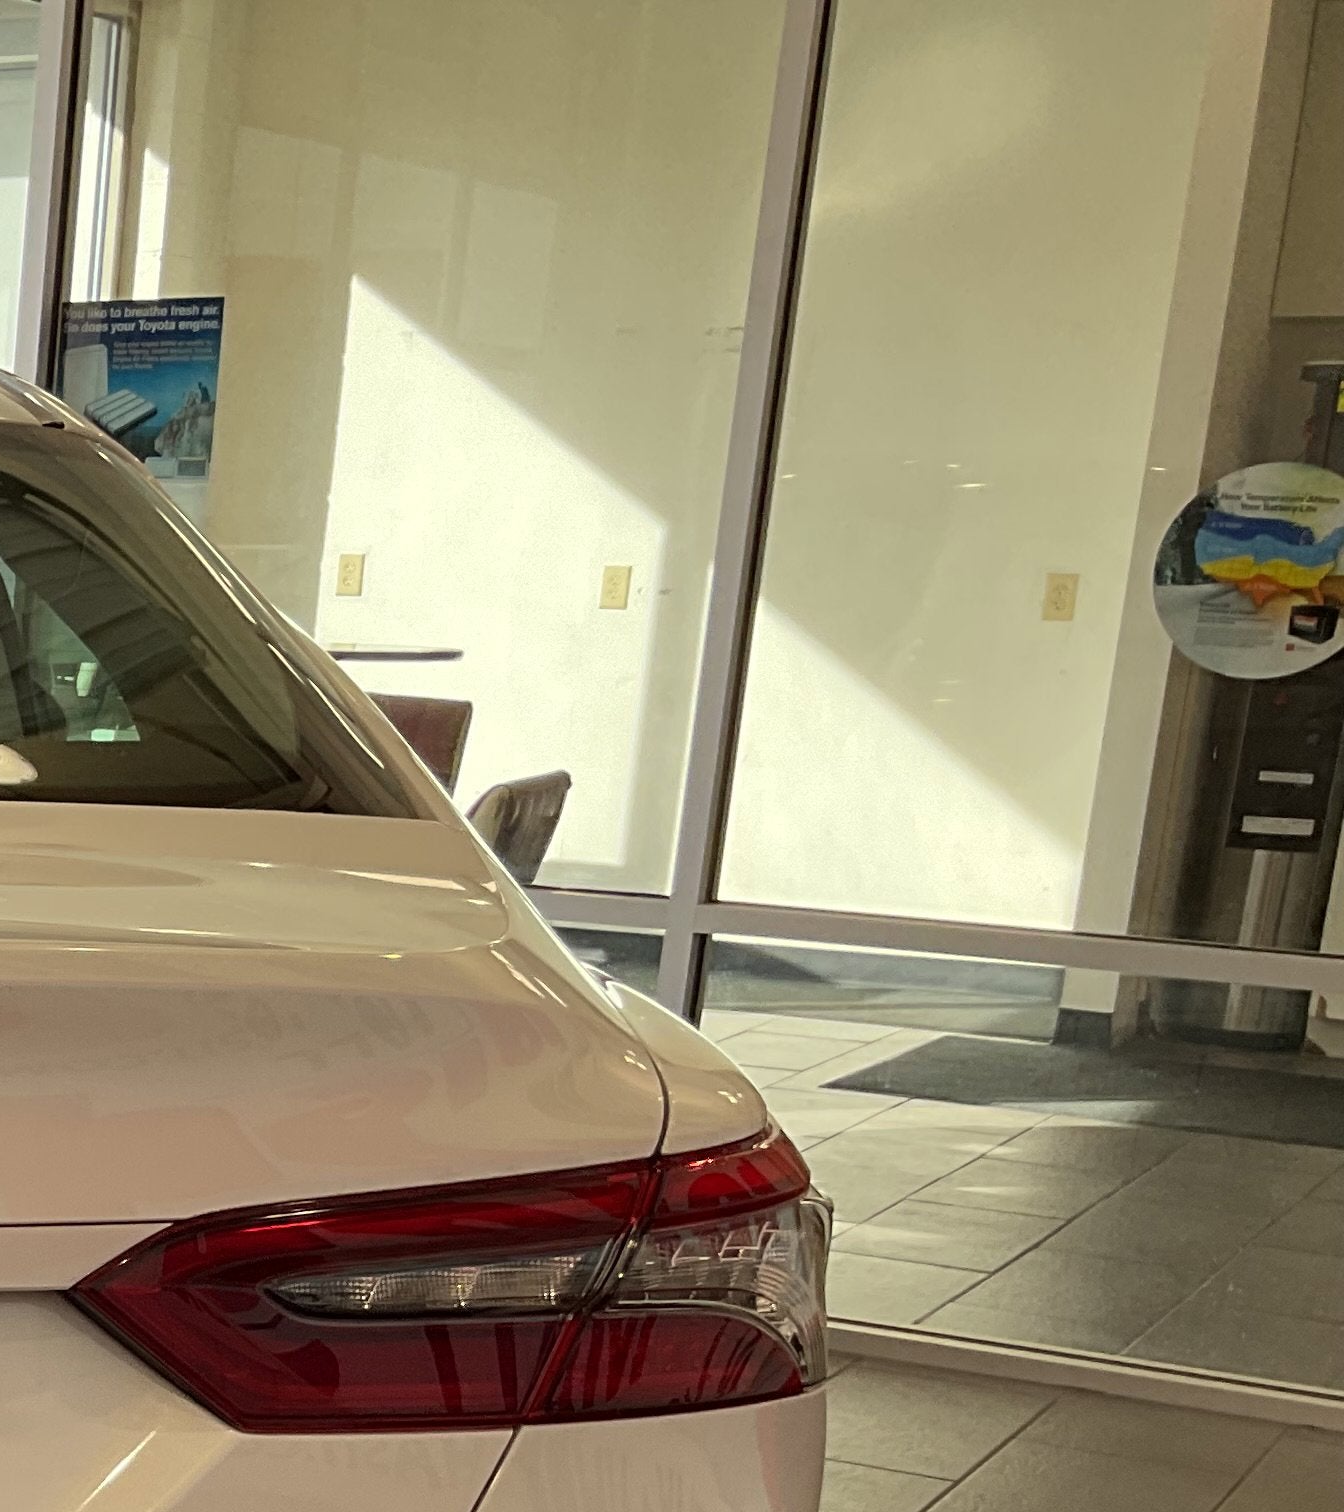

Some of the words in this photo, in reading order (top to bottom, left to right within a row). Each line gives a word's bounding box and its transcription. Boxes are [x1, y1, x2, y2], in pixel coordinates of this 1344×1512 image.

[110, 306, 122, 318] to
[124, 305, 168, 318] breathe
[170, 304, 199, 316] fresh
[202, 304, 219, 315] air.
[81, 320, 109, 333] does
[110, 321, 136, 334] your
[138, 319, 176, 333] Toyota
[178, 318, 220, 332] engine.
